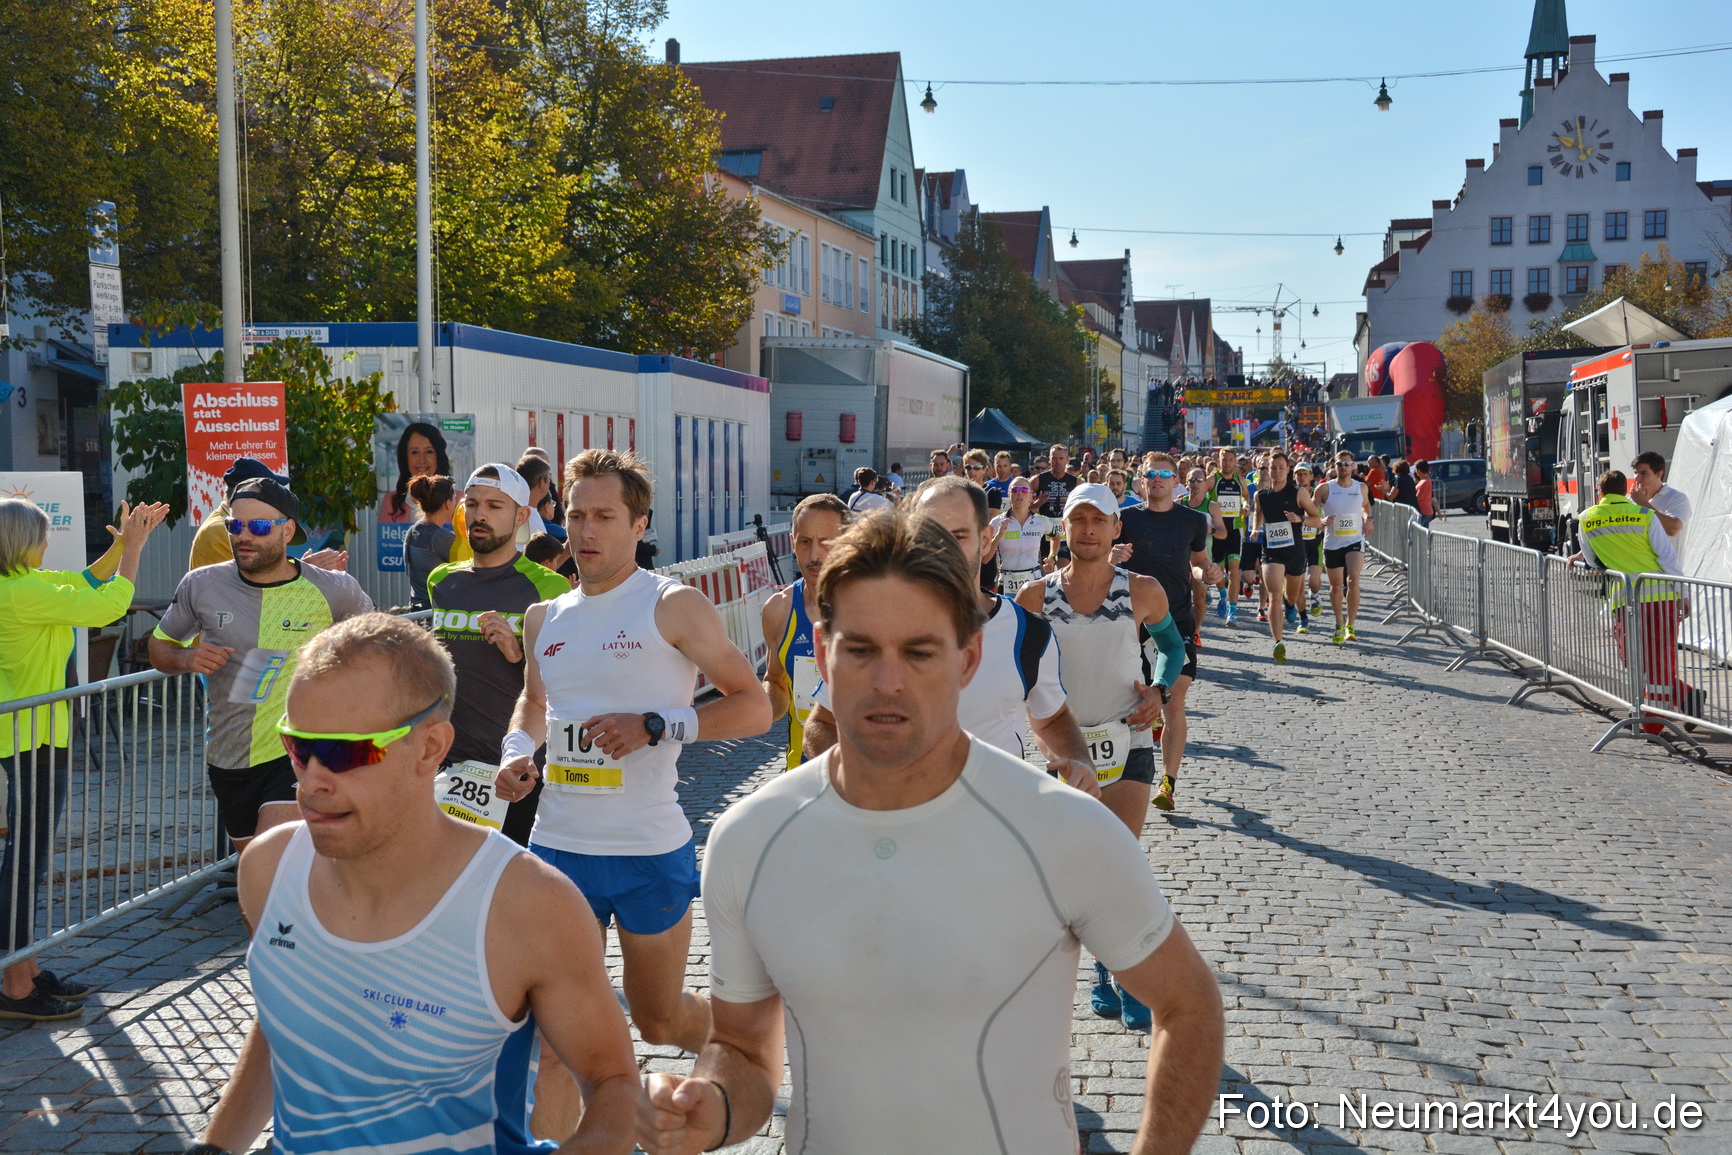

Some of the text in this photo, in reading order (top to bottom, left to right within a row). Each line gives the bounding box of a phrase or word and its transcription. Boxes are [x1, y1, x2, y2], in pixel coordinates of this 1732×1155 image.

[93, 280, 119, 291] Parkschein
[96, 292, 118, 302] werktags
[17, 386, 27, 408] 3
[193, 392, 278, 408] Abschluss
[1217, 391, 1254, 400] START
[193, 409, 222, 419] statt
[194, 419, 280, 433] Ausschluss!
[209, 440, 277, 450] Mehr Lehrer für
[206, 451, 278, 460] kleinere Klassen.
[1223, 501, 1236, 509] 243
[1586, 516, 1641, 528] Org.-Leiter
[381, 526, 407, 542] Helg
[1269, 528, 1289, 538] 2486
[381, 556, 403, 566] CSU
[447, 632, 458, 640] by
[460, 633, 486, 641] smart
[602, 641, 643, 651] LATVIJA
[1082, 729, 1109, 739] OCK
[1088, 740, 1114, 760] 19
[571, 757, 596, 765] Neumarkt
[564, 769, 590, 783] Toms
[1097, 771, 1109, 781] trii
[447, 776, 492, 807] 285
[460, 801, 482, 814] Neumarkt
[447, 806, 477, 824] Daniel
[269, 937, 295, 950] erima
[362, 988, 447, 1017] SKI-CLUB LAUF
